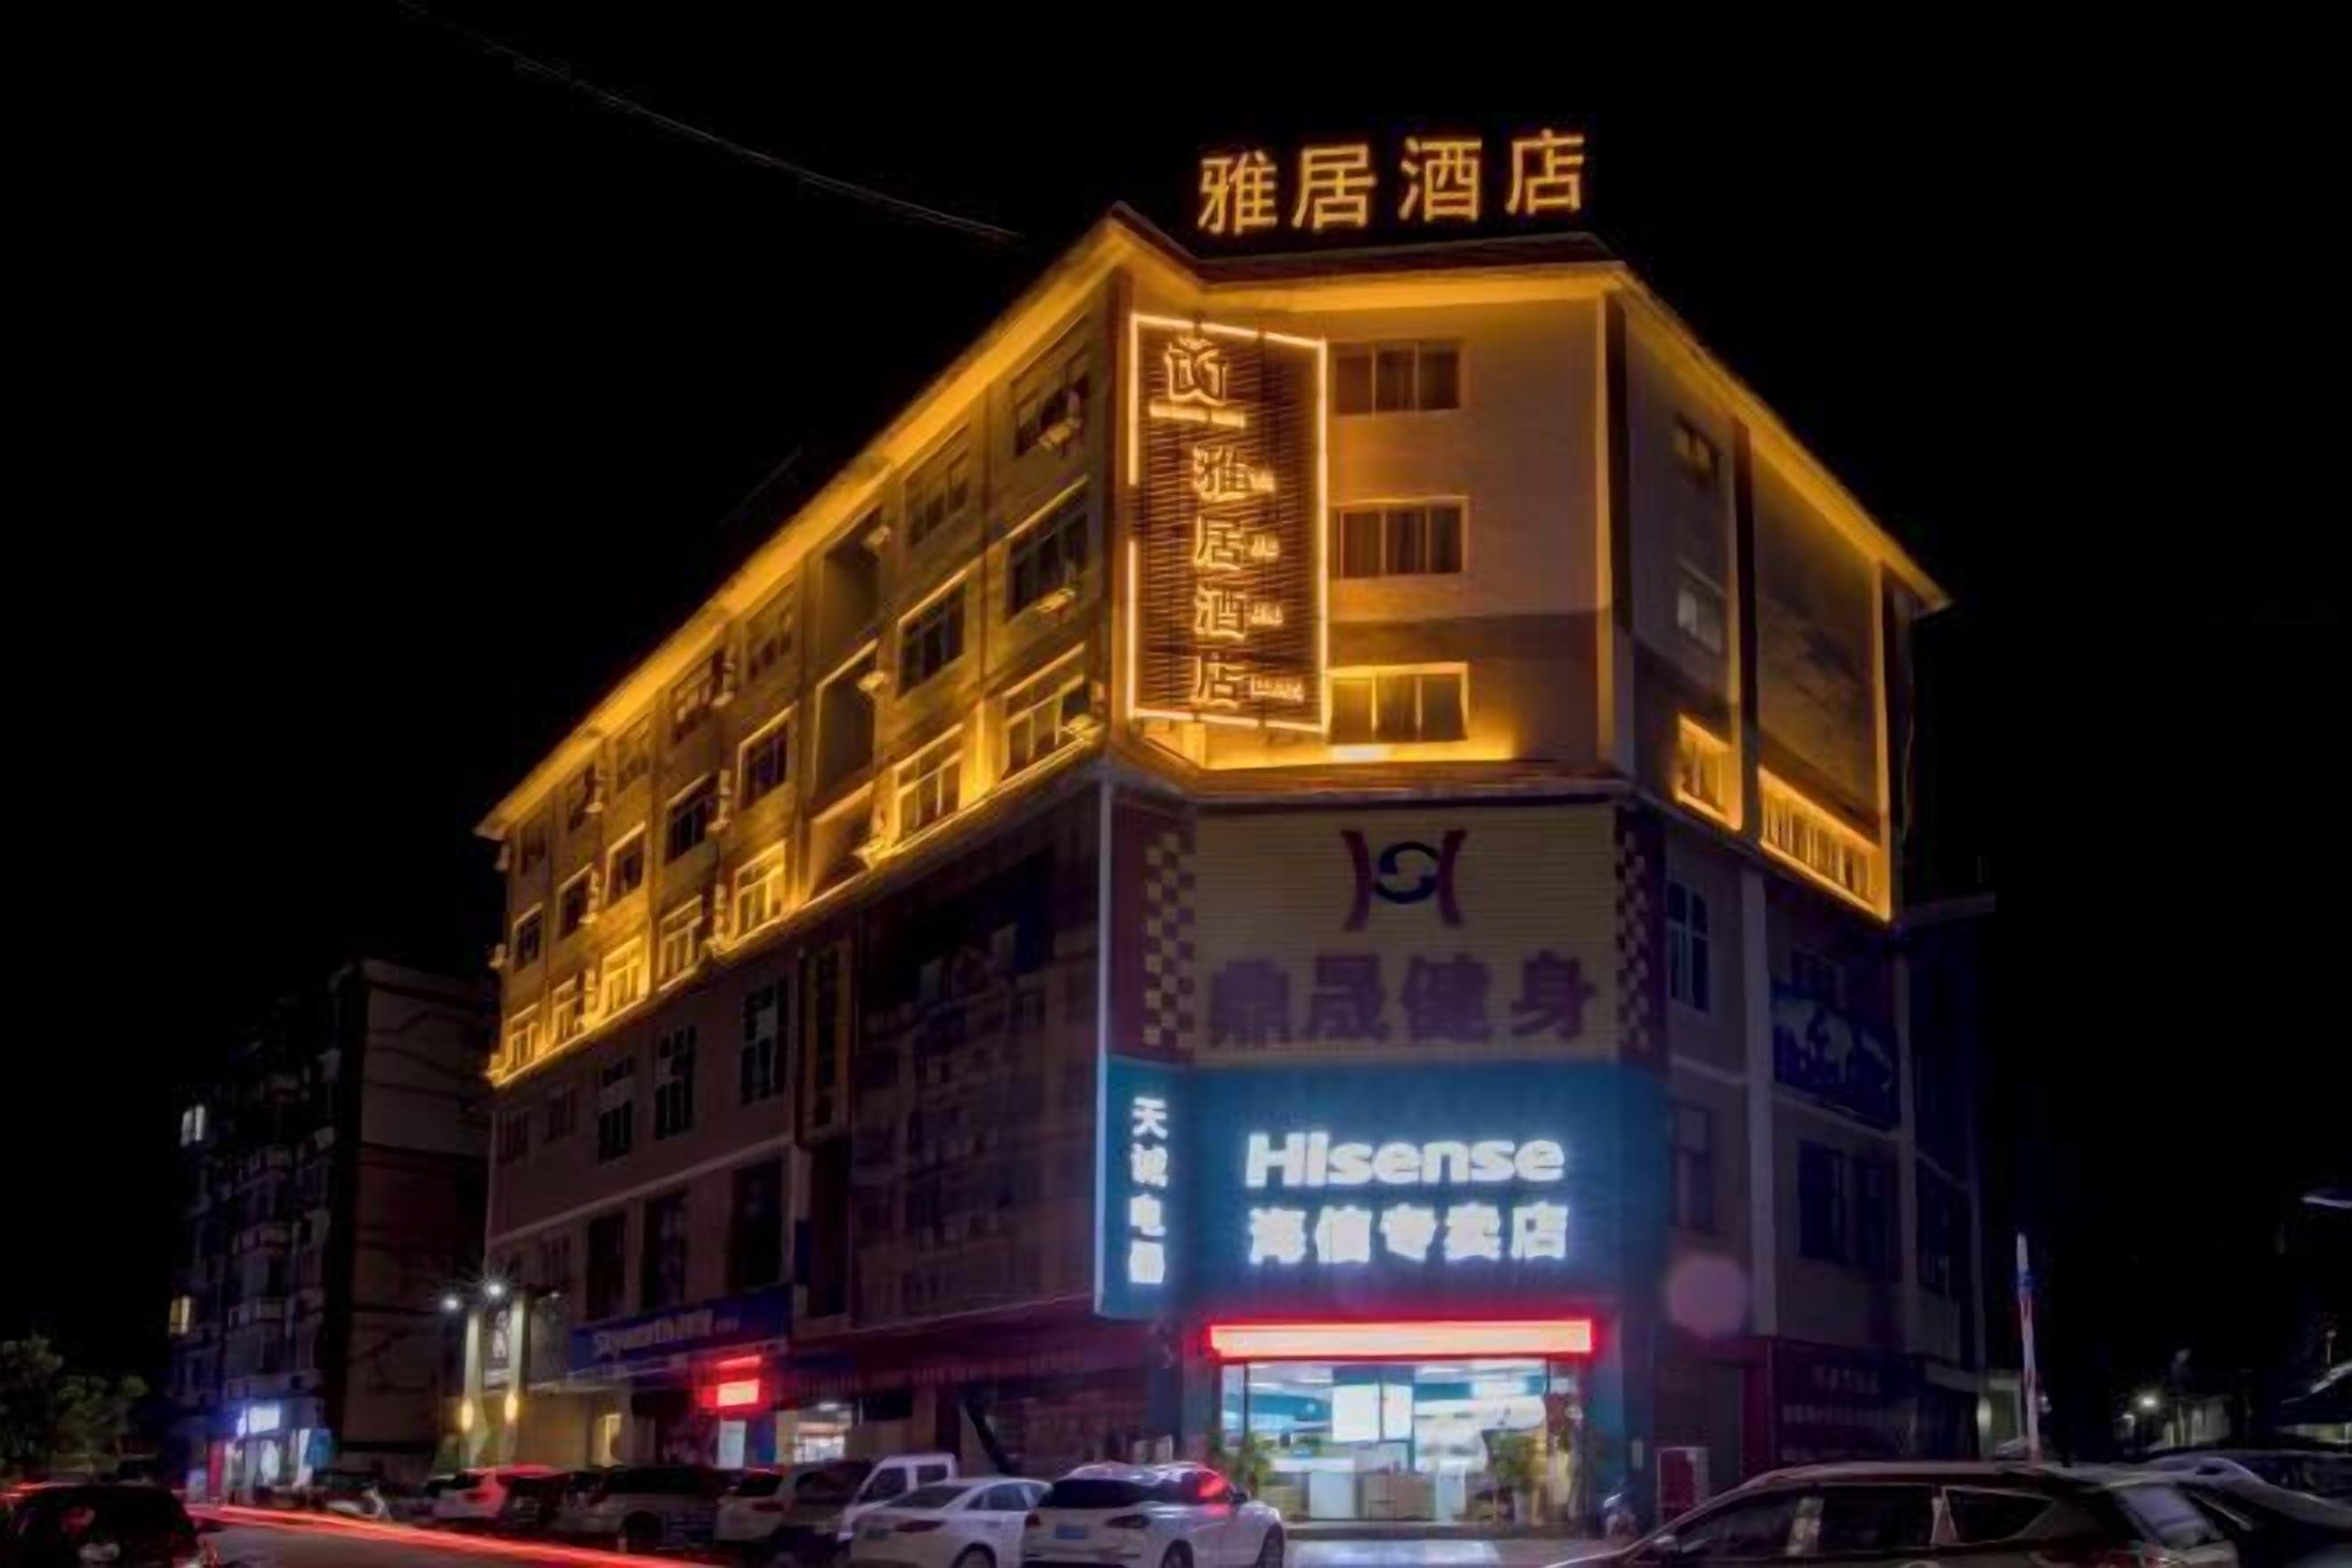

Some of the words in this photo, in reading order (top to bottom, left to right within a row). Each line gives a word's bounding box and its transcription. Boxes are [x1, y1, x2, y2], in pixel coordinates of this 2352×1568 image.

[1197, 127, 1586, 236] 雅居酒店
[1192, 445, 1249, 709] 雅居酒店
[1208, 948, 1598, 1049] 鼎晟健身
[1245, 1131, 1566, 1188] Hisense
[1249, 1200, 1569, 1266] 海信专卖店
